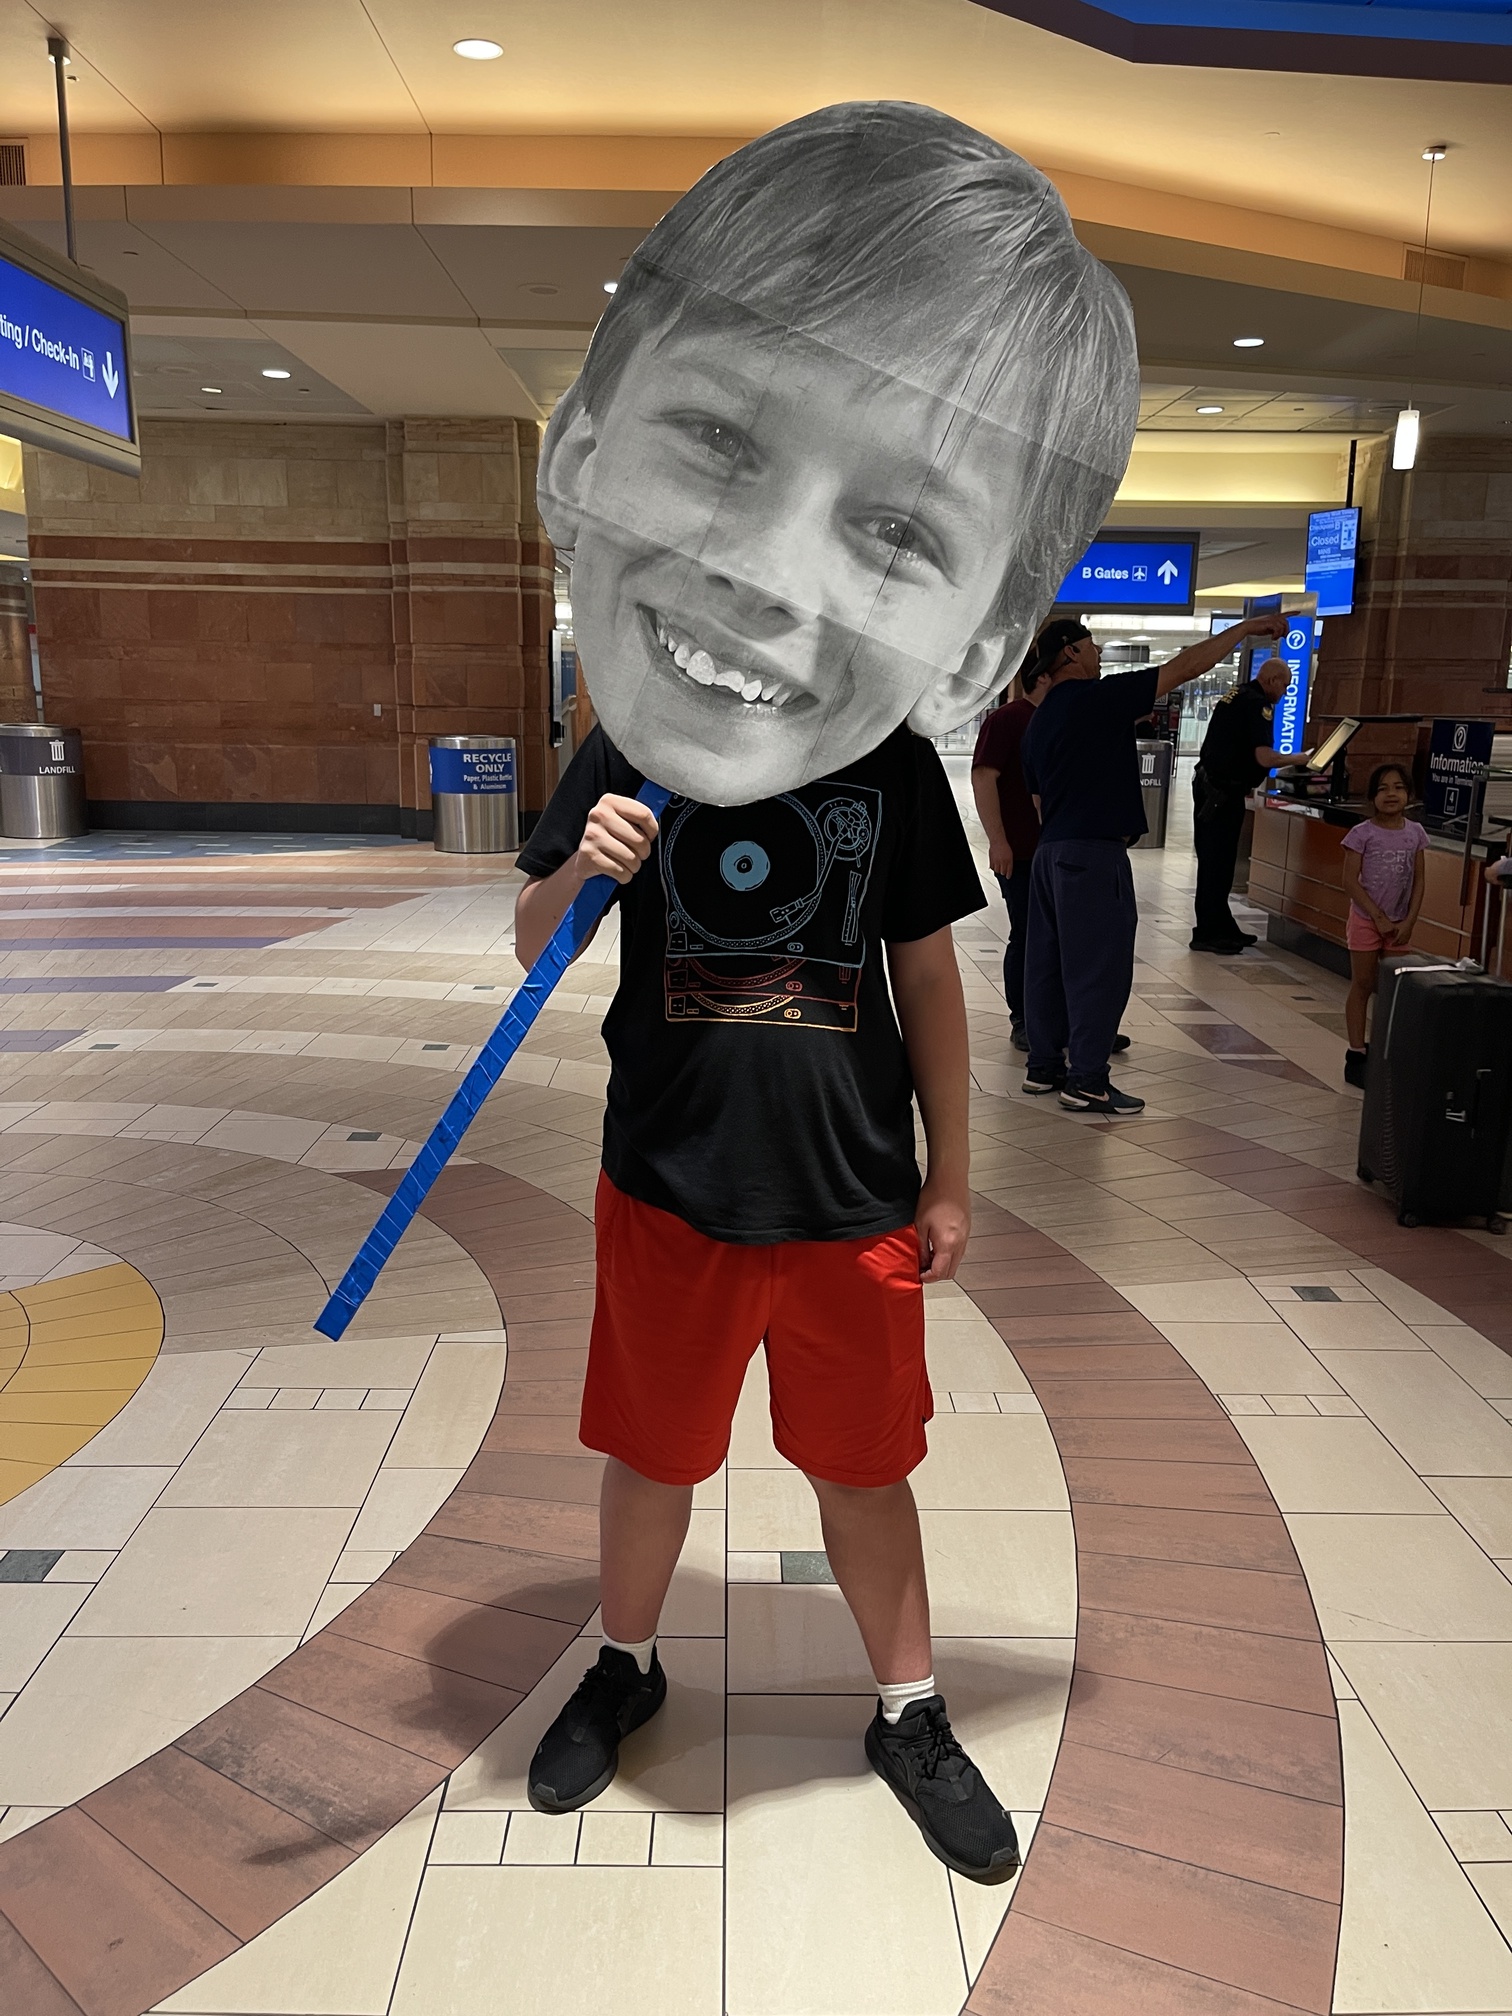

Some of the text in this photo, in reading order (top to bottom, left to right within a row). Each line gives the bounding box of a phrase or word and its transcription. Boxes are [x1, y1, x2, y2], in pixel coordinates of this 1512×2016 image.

[24, 325, 29, 347] /
[32, 328, 80, 371] Check-In
[1311, 533, 1340, 547] Closed
[1082, 566, 1129, 580] B Gates
[463, 753, 512, 763] RECYCLE
[1430, 752, 1485, 775] Information
[39, 766, 76, 774] LANDFILL
[475, 764, 505, 773] ONLY
[1449, 792, 1455, 803] 4
